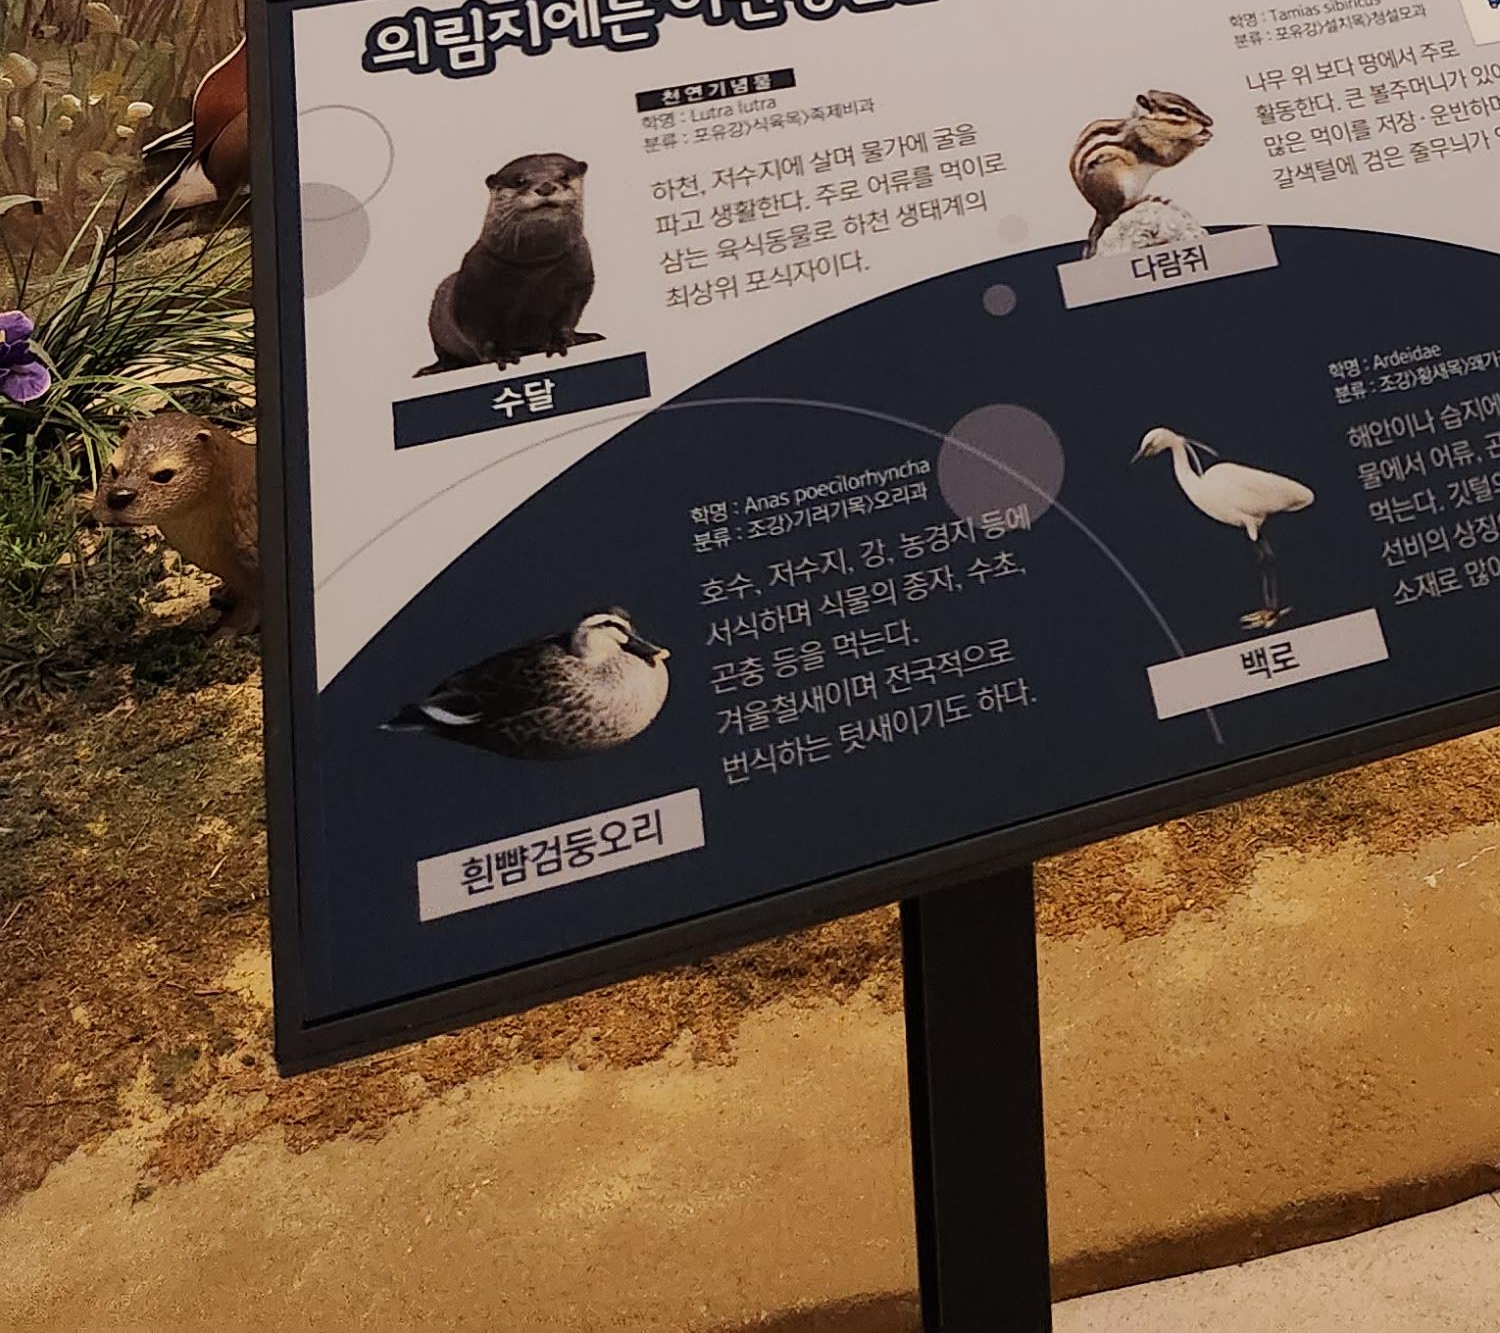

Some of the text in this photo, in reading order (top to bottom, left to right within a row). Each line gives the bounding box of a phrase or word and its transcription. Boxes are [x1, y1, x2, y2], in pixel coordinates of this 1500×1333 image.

[1244, 38, 1461, 92] 나무 위 보다 땅에서 주로
[1254, 91, 1342, 126] 활동한다.
[1343, 86, 1366, 110] 큰
[1368, 67, 1468, 105] 볼주머니가
[650, 122, 977, 201] 하천, 저수지에 살며 물가에 굴을
[1262, 130, 1307, 158] 많은
[1308, 117, 1372, 146] 먹이를
[1374, 109, 1417, 134] 저장
[1271, 153, 1359, 190] 갈색털에
[1360, 145, 1405, 173] 검은
[1408, 128, 1491, 164] 줄무늬가
[654, 151, 1007, 237] 파고 생활한다. 주로 어류를 먹이로
[659, 188, 988, 275] 삼는 육식동물로 하천 생태계의
[665, 248, 870, 308] 최상위 포식자이다.
[1129, 243, 1209, 282] 다람쥐
[1372, 343, 1442, 371] Ardeidae
[491, 377, 555, 418] 수달
[743, 490, 790, 515] Anas
[792, 459, 931, 506] poecilorhyncha
[1367, 486, 1445, 525] 먹는다.
[699, 503, 1033, 605] 호수, 저수지, 강, 농경지 등에
[1380, 525, 1451, 567] 선비의
[705, 549, 1026, 646] 서식하며 식물의 종자, 수초,
[1392, 566, 1463, 605] 소재로
[709, 618, 920, 694] 곤충 등을 먹는다.
[1238, 640, 1300, 679] 백로
[716, 637, 1015, 735] 겨울철새이며 전국적으로
[722, 676, 1037, 785] 번식하는 텃새이기도 하다.
[459, 807, 664, 896] 흰뺨검둥오리
